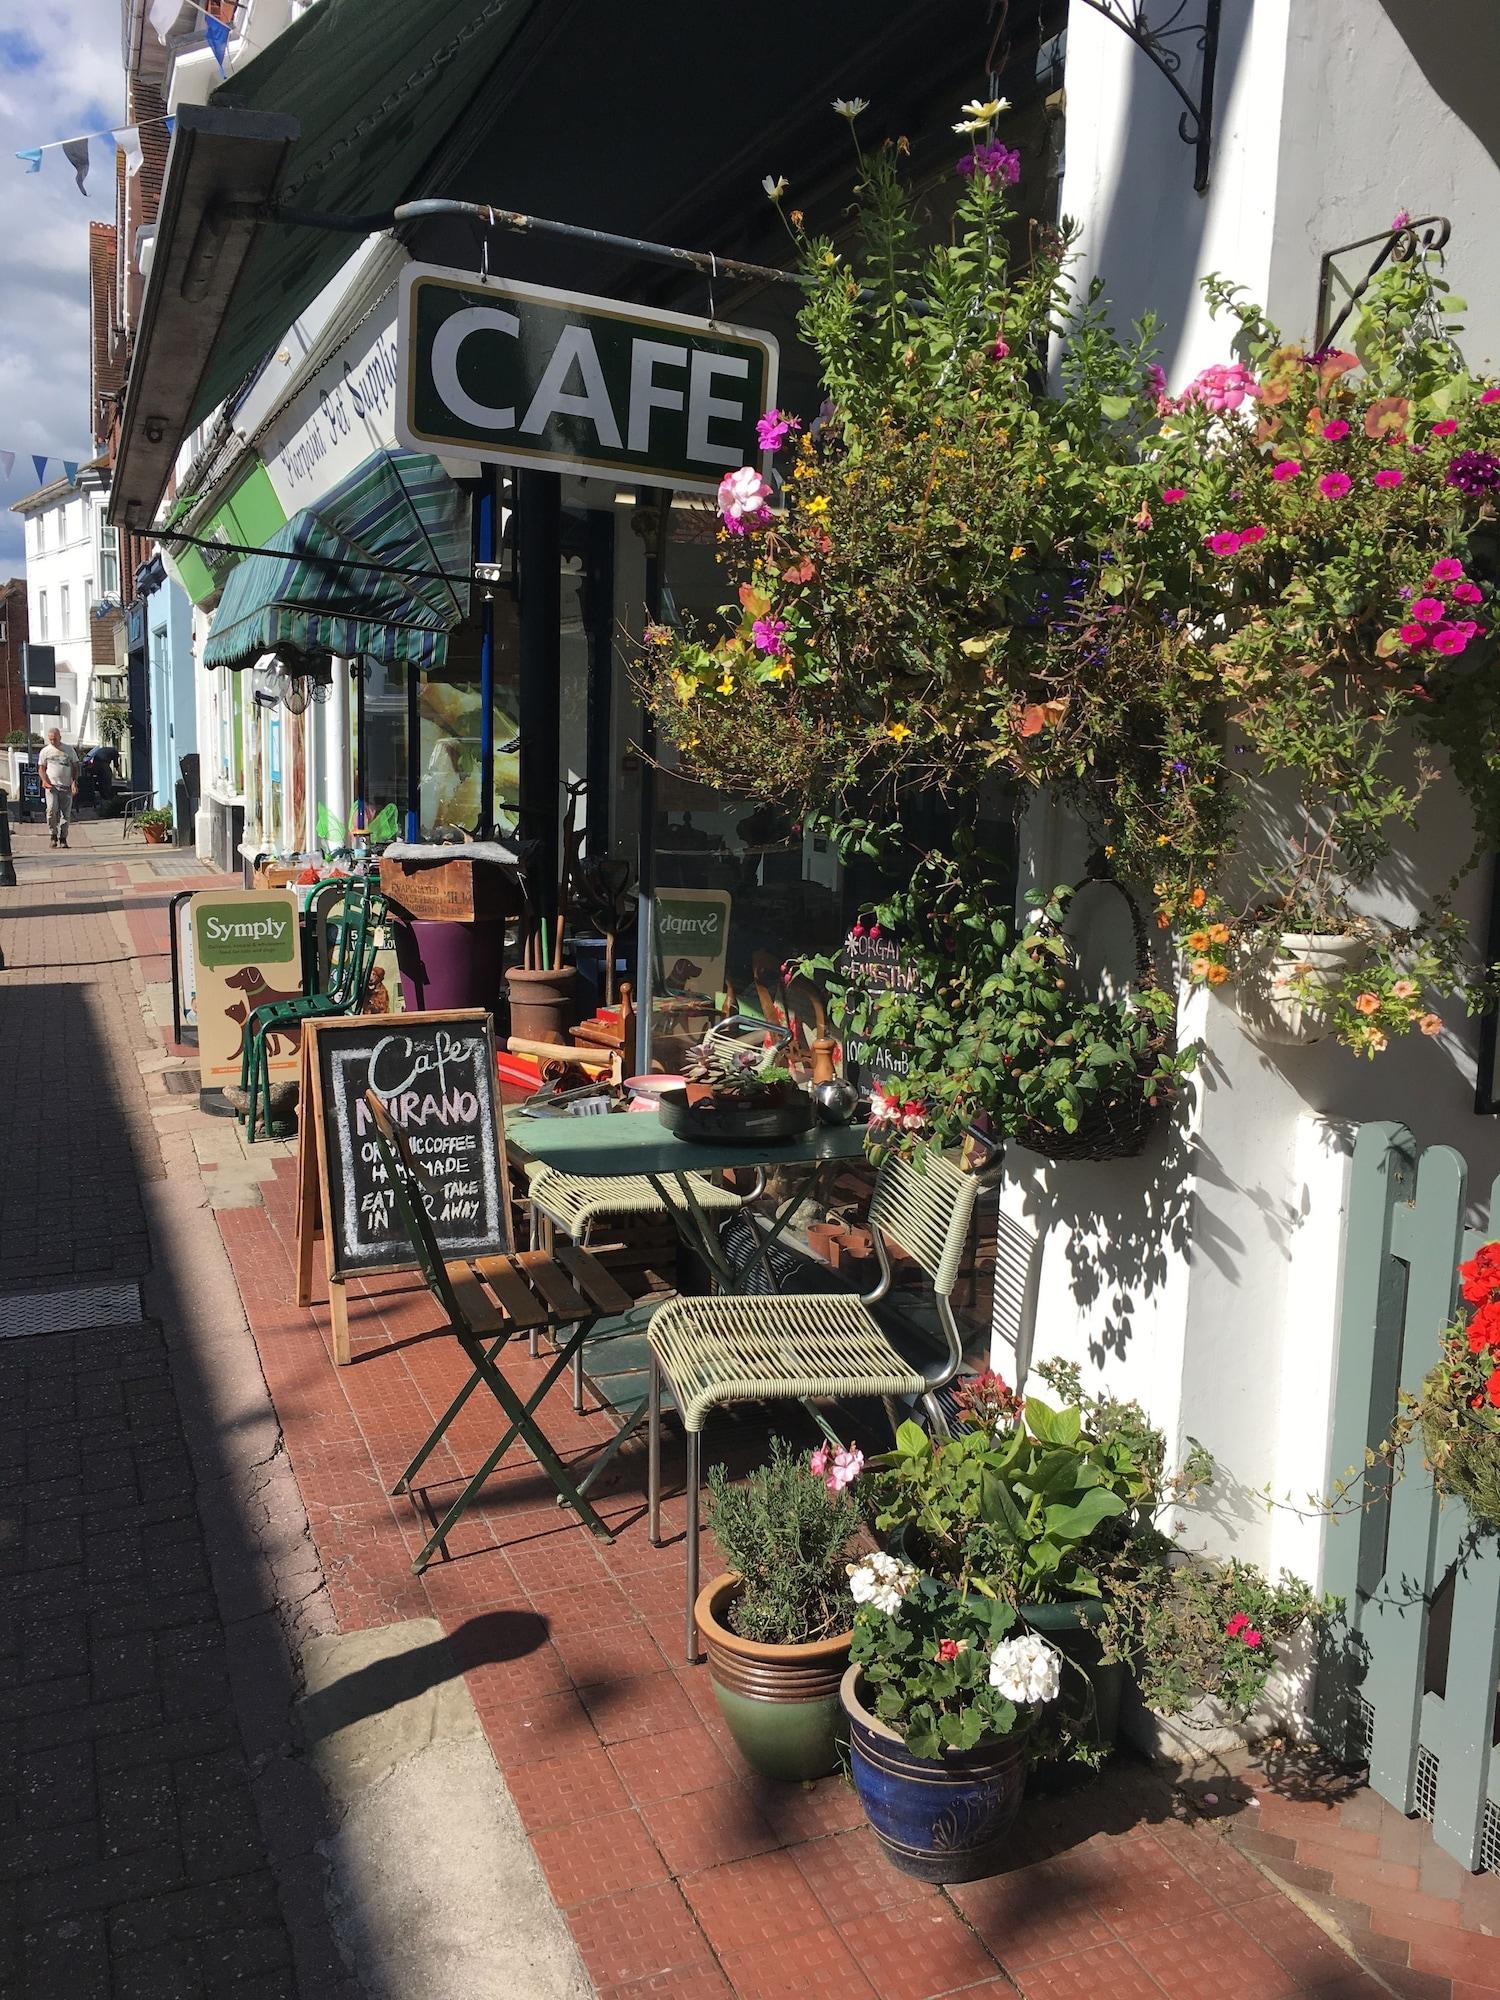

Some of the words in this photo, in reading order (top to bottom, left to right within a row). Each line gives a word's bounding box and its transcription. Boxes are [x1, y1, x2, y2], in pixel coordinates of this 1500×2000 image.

[431, 306, 749, 467] CAFE
[206, 916, 287, 942] Symply
[368, 1031, 476, 1099] Cafe
[425, 1134, 476, 1155] COFFEE
[360, 1189, 395, 1212] EAT
[440, 1180, 479, 1199] TAKE
[367, 1208, 389, 1230] IN
[440, 1199, 479, 1221] AWAY
